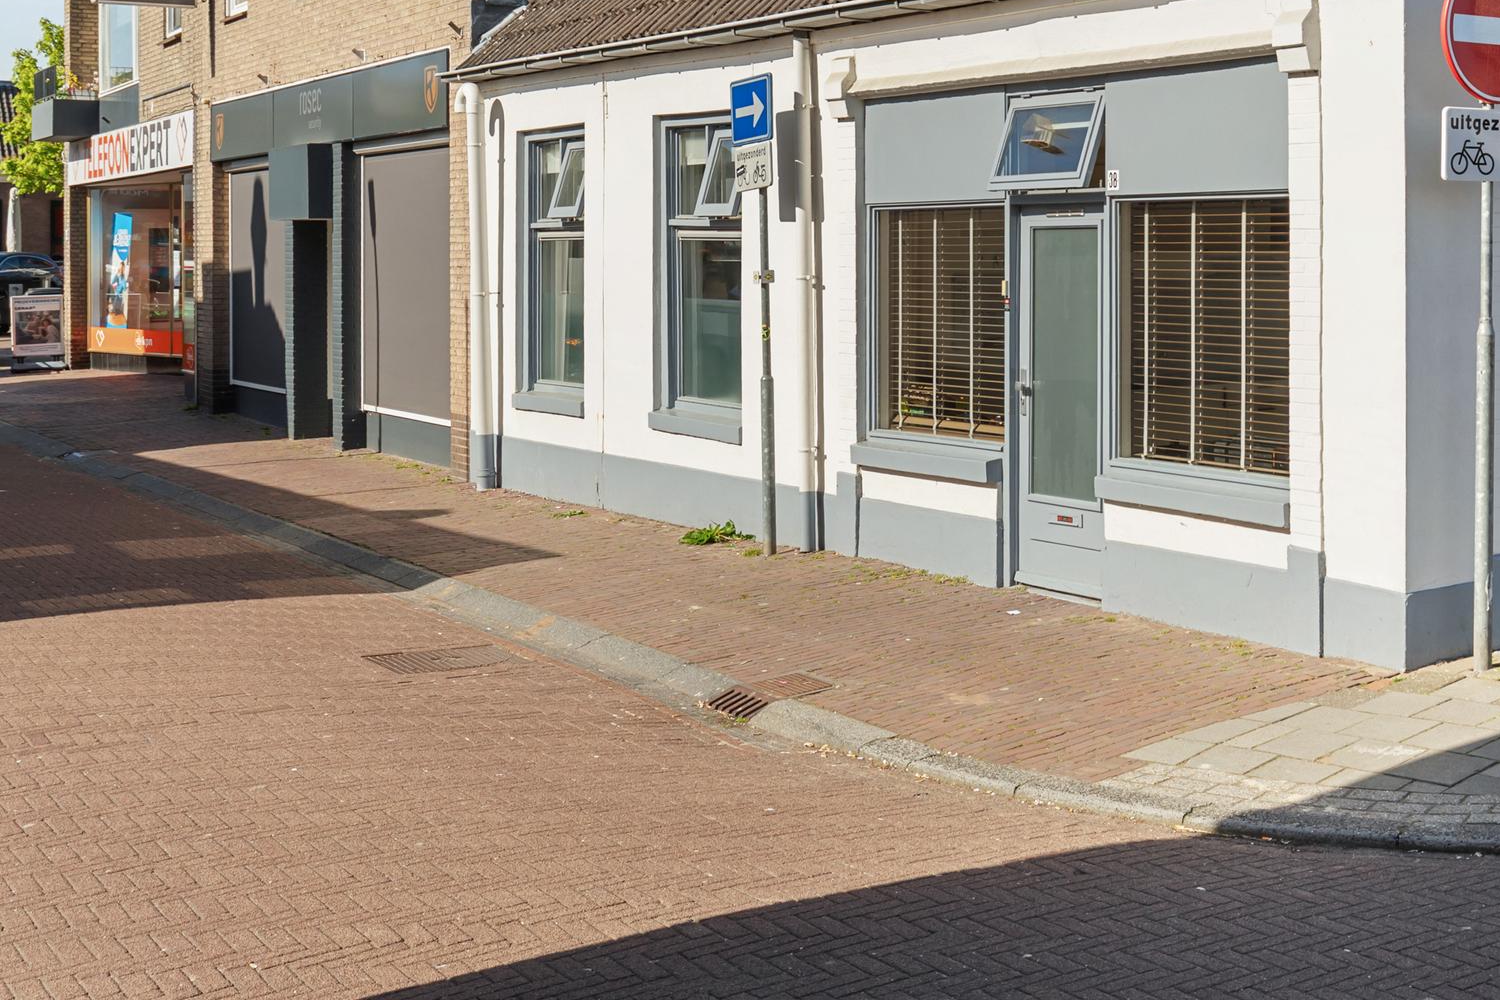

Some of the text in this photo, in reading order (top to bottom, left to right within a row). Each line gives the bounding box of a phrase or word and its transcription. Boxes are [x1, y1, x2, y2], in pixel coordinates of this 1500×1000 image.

[299, 87, 322, 115] rosec
[737, 148, 766, 161] uitgezonderd
[1108, 172, 1118, 188] 38
